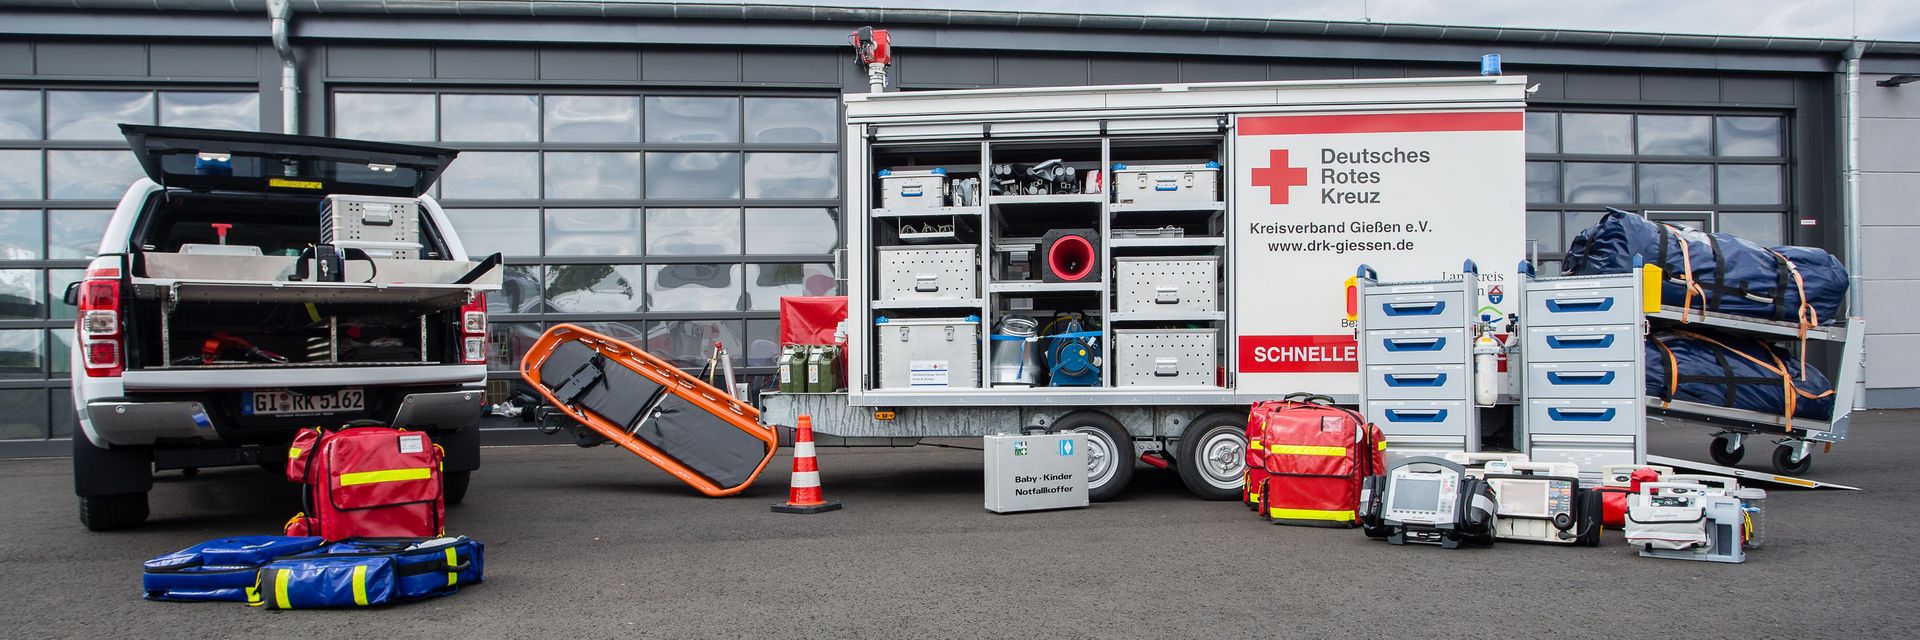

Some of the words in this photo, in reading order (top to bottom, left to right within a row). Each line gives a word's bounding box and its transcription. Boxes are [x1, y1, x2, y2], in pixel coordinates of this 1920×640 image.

[1321, 147, 1431, 165] Deutsches
[1321, 168, 1381, 185] Rotes
[1321, 187, 1381, 205] Kreuz
[1250, 221, 1345, 235] Kreisverband
[1350, 221, 1401, 234] Gießen
[1405, 220, 1432, 233] e.V.
[1267, 238, 1414, 255] www.drk-giessen.de
[1254, 346, 1357, 362] SCHNELLE
[255, 393, 277, 412] GI
[293, 394, 315, 411] RK
[320, 391, 363, 410] 5162
[1015, 475, 1038, 484] Baby
[1043, 473, 1073, 482] Kinder
[1015, 485, 1074, 496] Notfallkoffer
